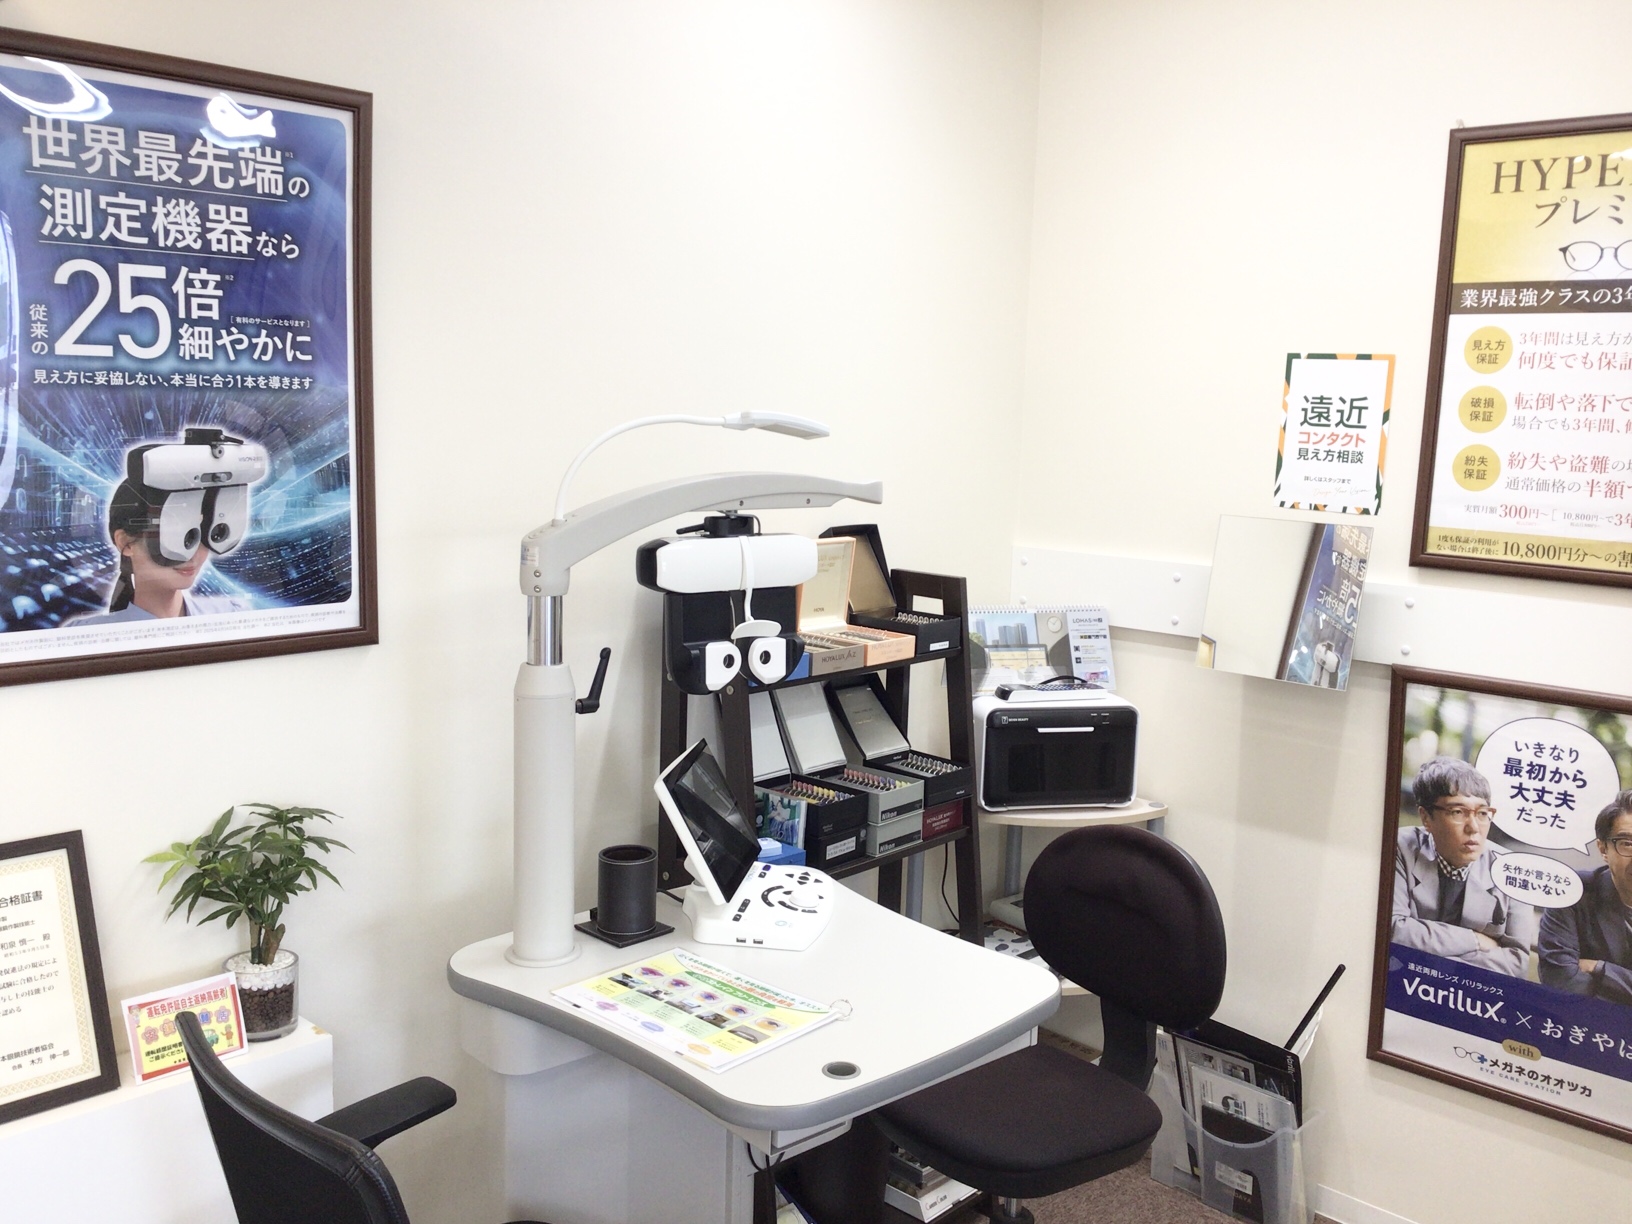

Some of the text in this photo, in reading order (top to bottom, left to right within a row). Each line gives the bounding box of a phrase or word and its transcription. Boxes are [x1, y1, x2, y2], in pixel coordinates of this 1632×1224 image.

[22, 114, 310, 198] 世界最先端の
[1490, 152, 1632, 194] HYPE
[40, 183, 300, 260] 測定機器なら
[1535, 195, 1626, 229] プレミ
[29, 303, 49, 355] 従来の
[178, 323, 313, 361] 細やかに
[1472, 339, 1506, 351] 見え方
[1476, 353, 1499, 365] 保証
[1300, 394, 1369, 430] 遠近
[1470, 397, 1494, 409] 破損
[1469, 410, 1493, 422] 保証
[1298, 431, 1366, 448] コンタクト
[1297, 448, 1364, 464] 見え方相談
[1464, 455, 1488, 467] 紛失
[1463, 468, 1487, 481] 保証
[1514, 740, 1579, 763] いきなり
[1503, 757, 1588, 789] 最初から
[1510, 782, 1576, 811] 大丈夫
[881, 810, 898, 821] Nikon
[1516, 806, 1566, 829] だった
[879, 842, 896, 852] Nikon
[1503, 863, 1571, 886] 矢作が言うなら
[1505, 875, 1566, 896] 間違いない
[1408, 962, 1504, 997] 遠近両用レンズ バリラックス
[1508, 1044, 1535, 1059] with
[1480, 1067, 1561, 1096] EYE CARE STATION
[1489, 1059, 1592, 1098] メガネのオオツカ
